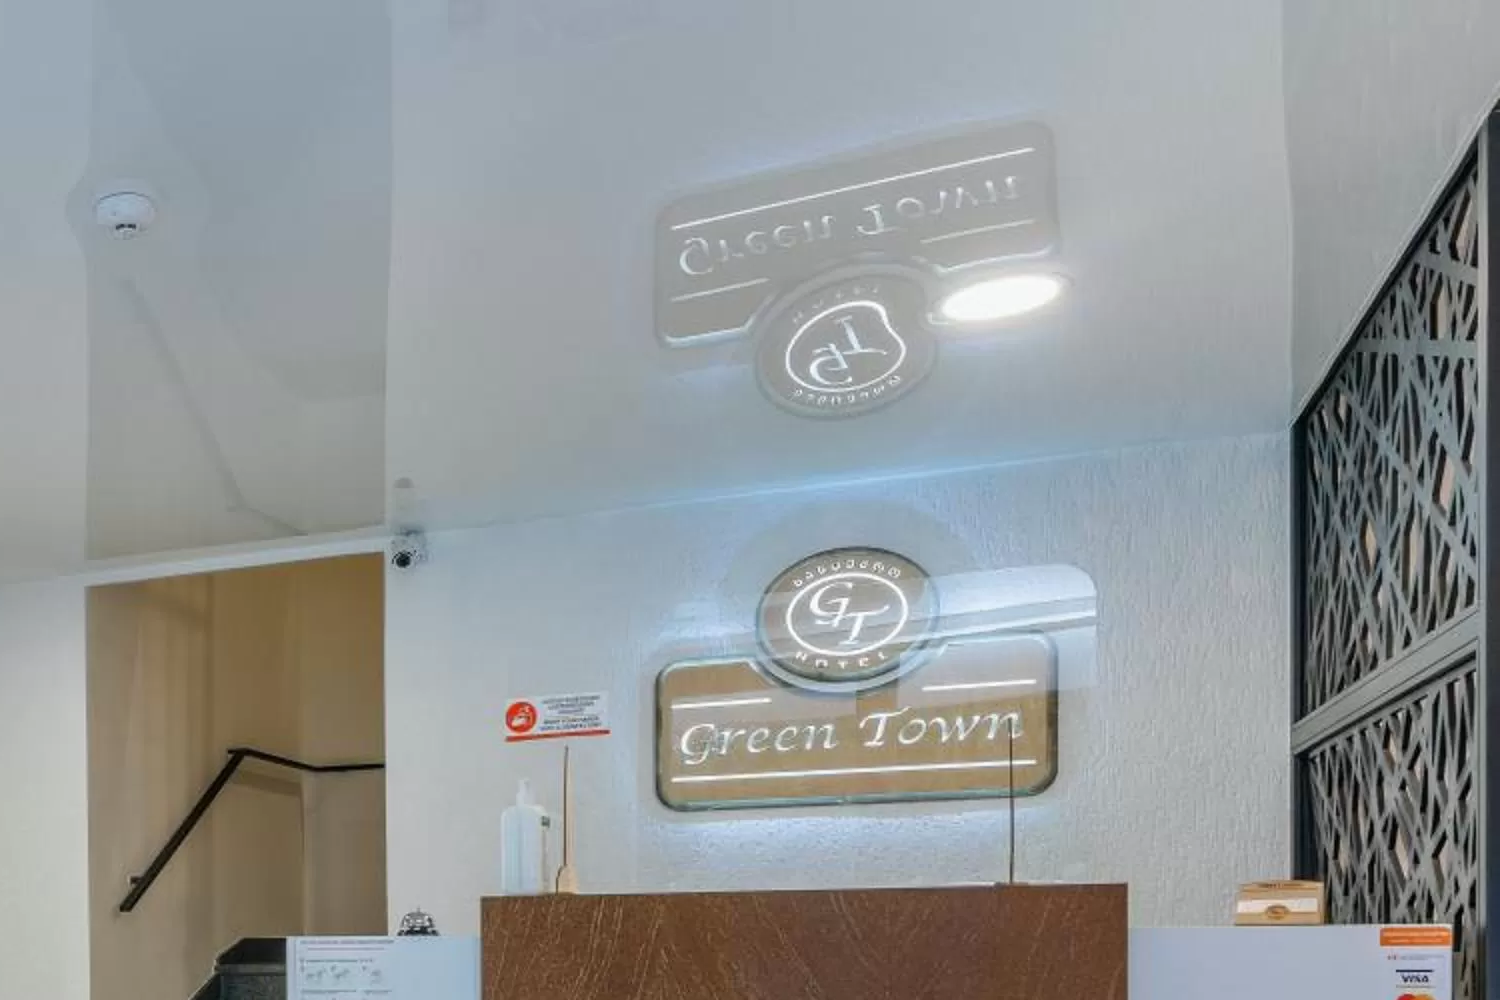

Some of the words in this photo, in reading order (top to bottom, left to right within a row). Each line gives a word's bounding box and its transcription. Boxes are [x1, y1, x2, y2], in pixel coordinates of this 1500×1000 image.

[809, 581, 892, 645] GT
[679, 722, 838, 766] Green
[859, 706, 1025, 748] Town
